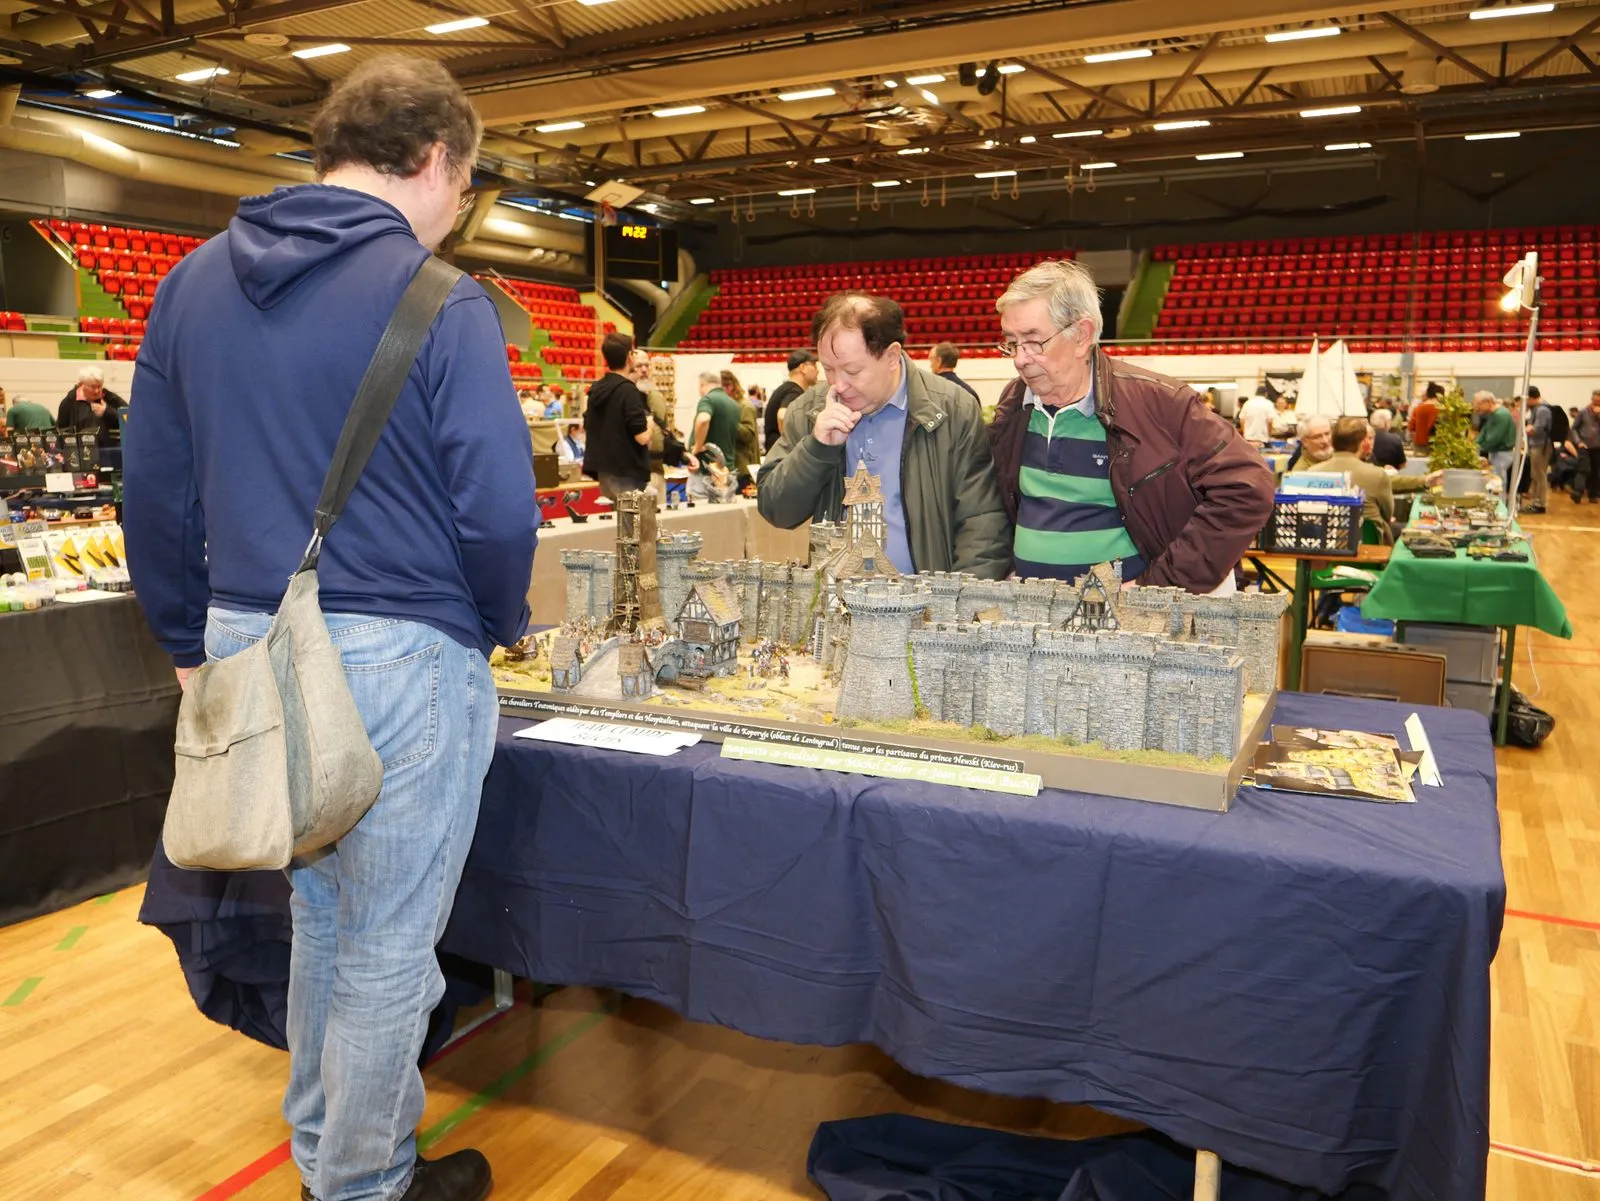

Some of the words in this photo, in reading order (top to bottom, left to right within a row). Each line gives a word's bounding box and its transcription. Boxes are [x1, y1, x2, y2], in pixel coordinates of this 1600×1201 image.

[508, 698, 532, 708] chevaliers
[533, 700, 565, 713] Teutoniques
[590, 707, 599, 716] des
[600, 708, 627, 720] Templiers
[635, 713, 644, 721] des
[681, 719, 710, 731] attaquant
[711, 721, 719, 731] la
[719, 724, 732, 733] ville
[732, 726, 740, 734] de
[770, 730, 791, 741] (oblast
[792, 733, 800, 742] de
[842, 742, 860, 751] tenue
[862, 746, 875, 754] par
[875, 745, 884, 754] les
[885, 749, 918, 759] partisans
[919, 750, 928, 759] du
[929, 754, 952, 763] prince
[953, 755, 980, 766] Newski
